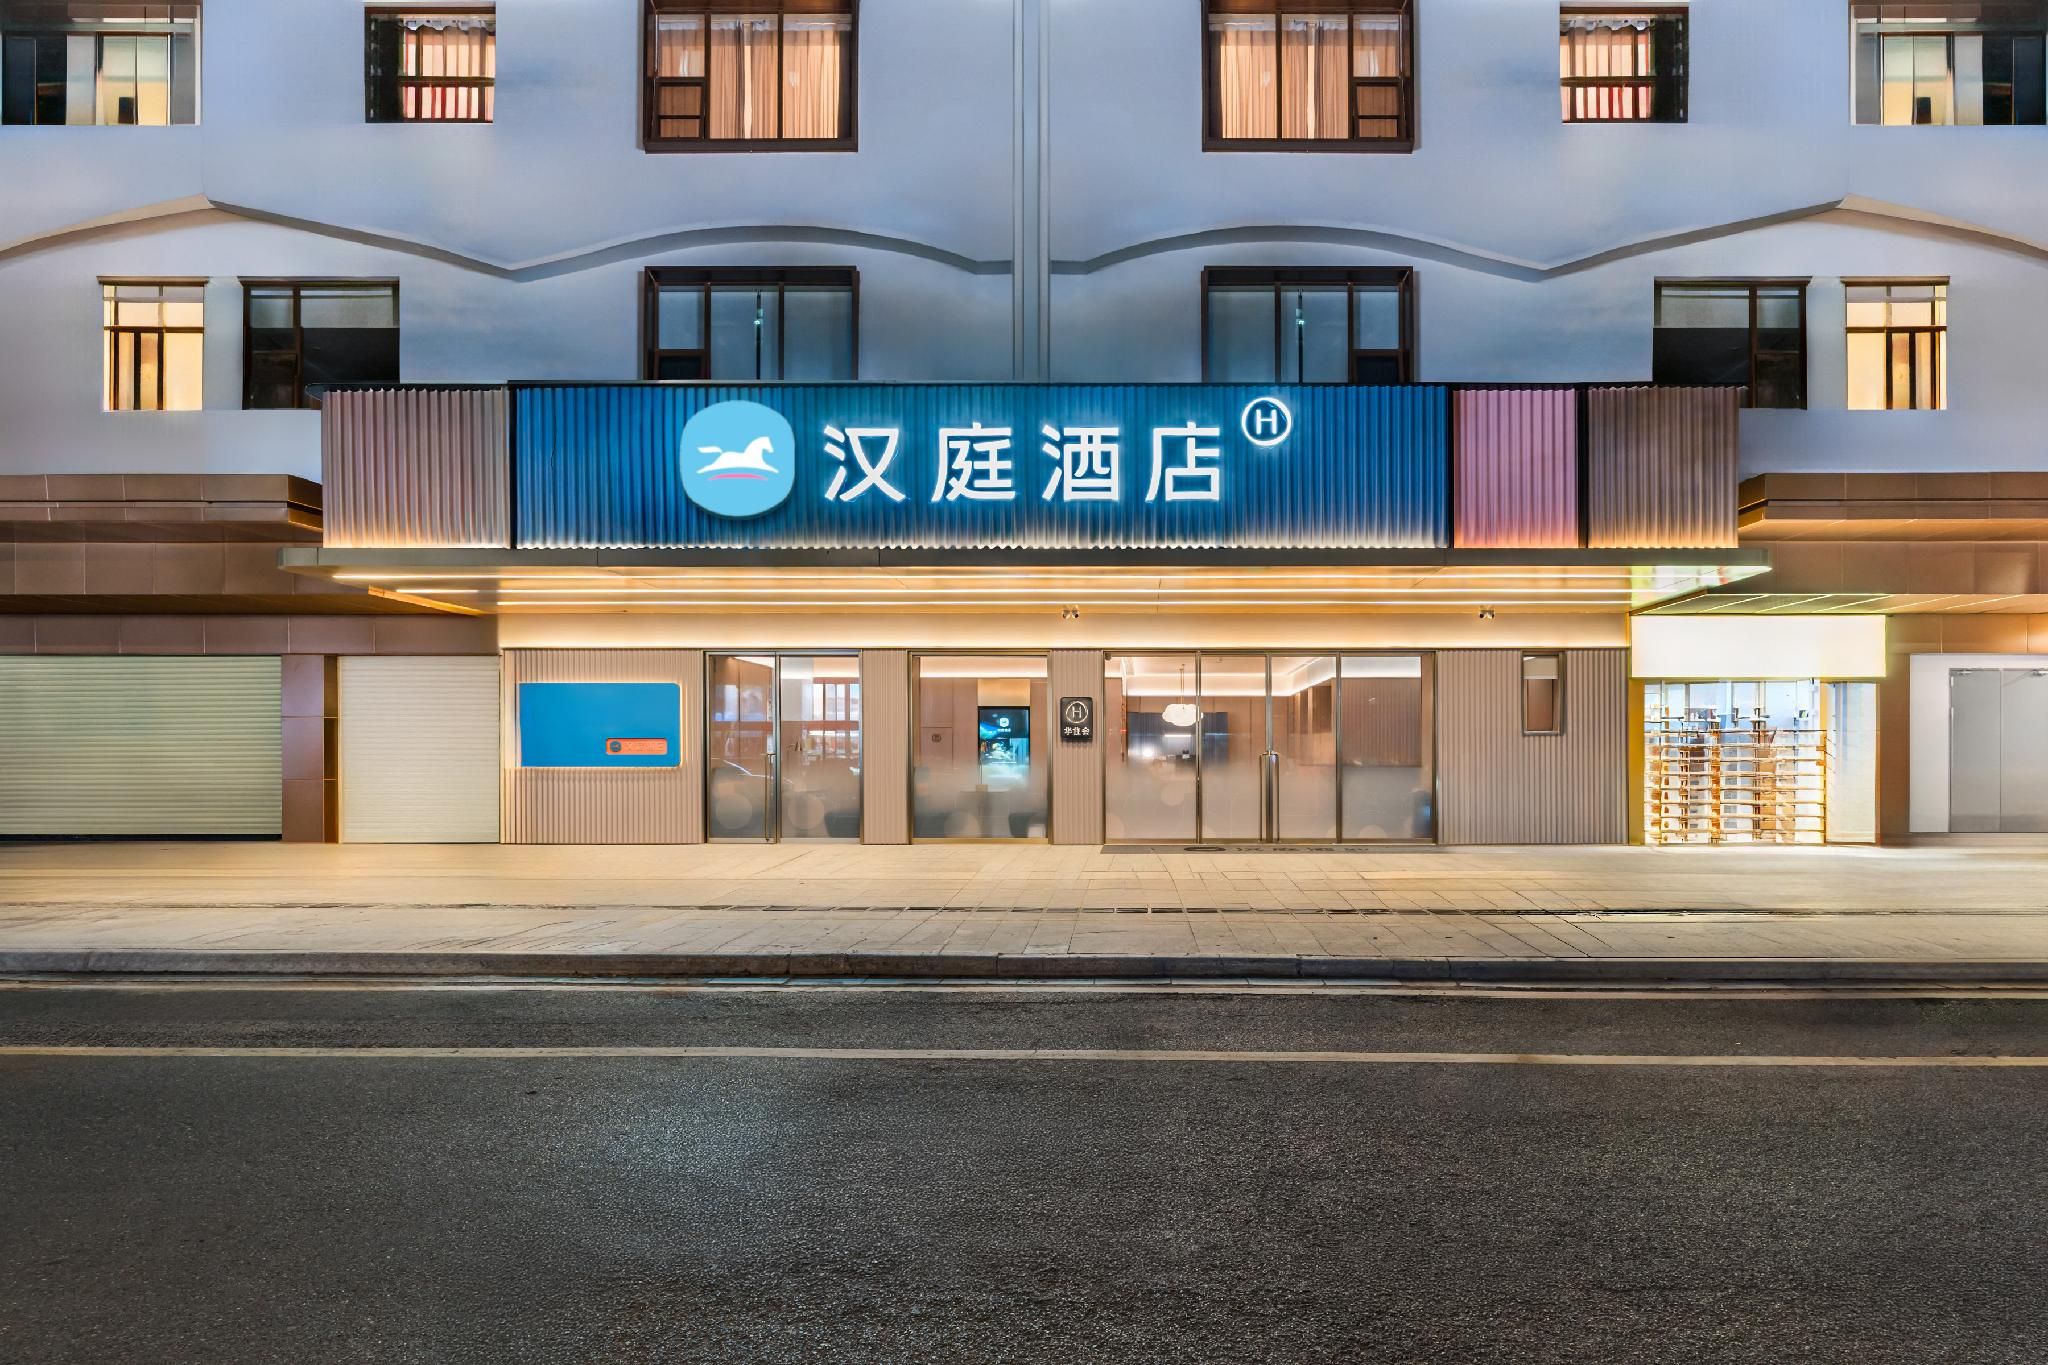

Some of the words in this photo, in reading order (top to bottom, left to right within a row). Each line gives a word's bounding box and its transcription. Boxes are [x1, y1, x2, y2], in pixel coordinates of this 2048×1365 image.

[1256, 409, 1277, 435] H
[824, 422, 1220, 502] 汉庭酒店
